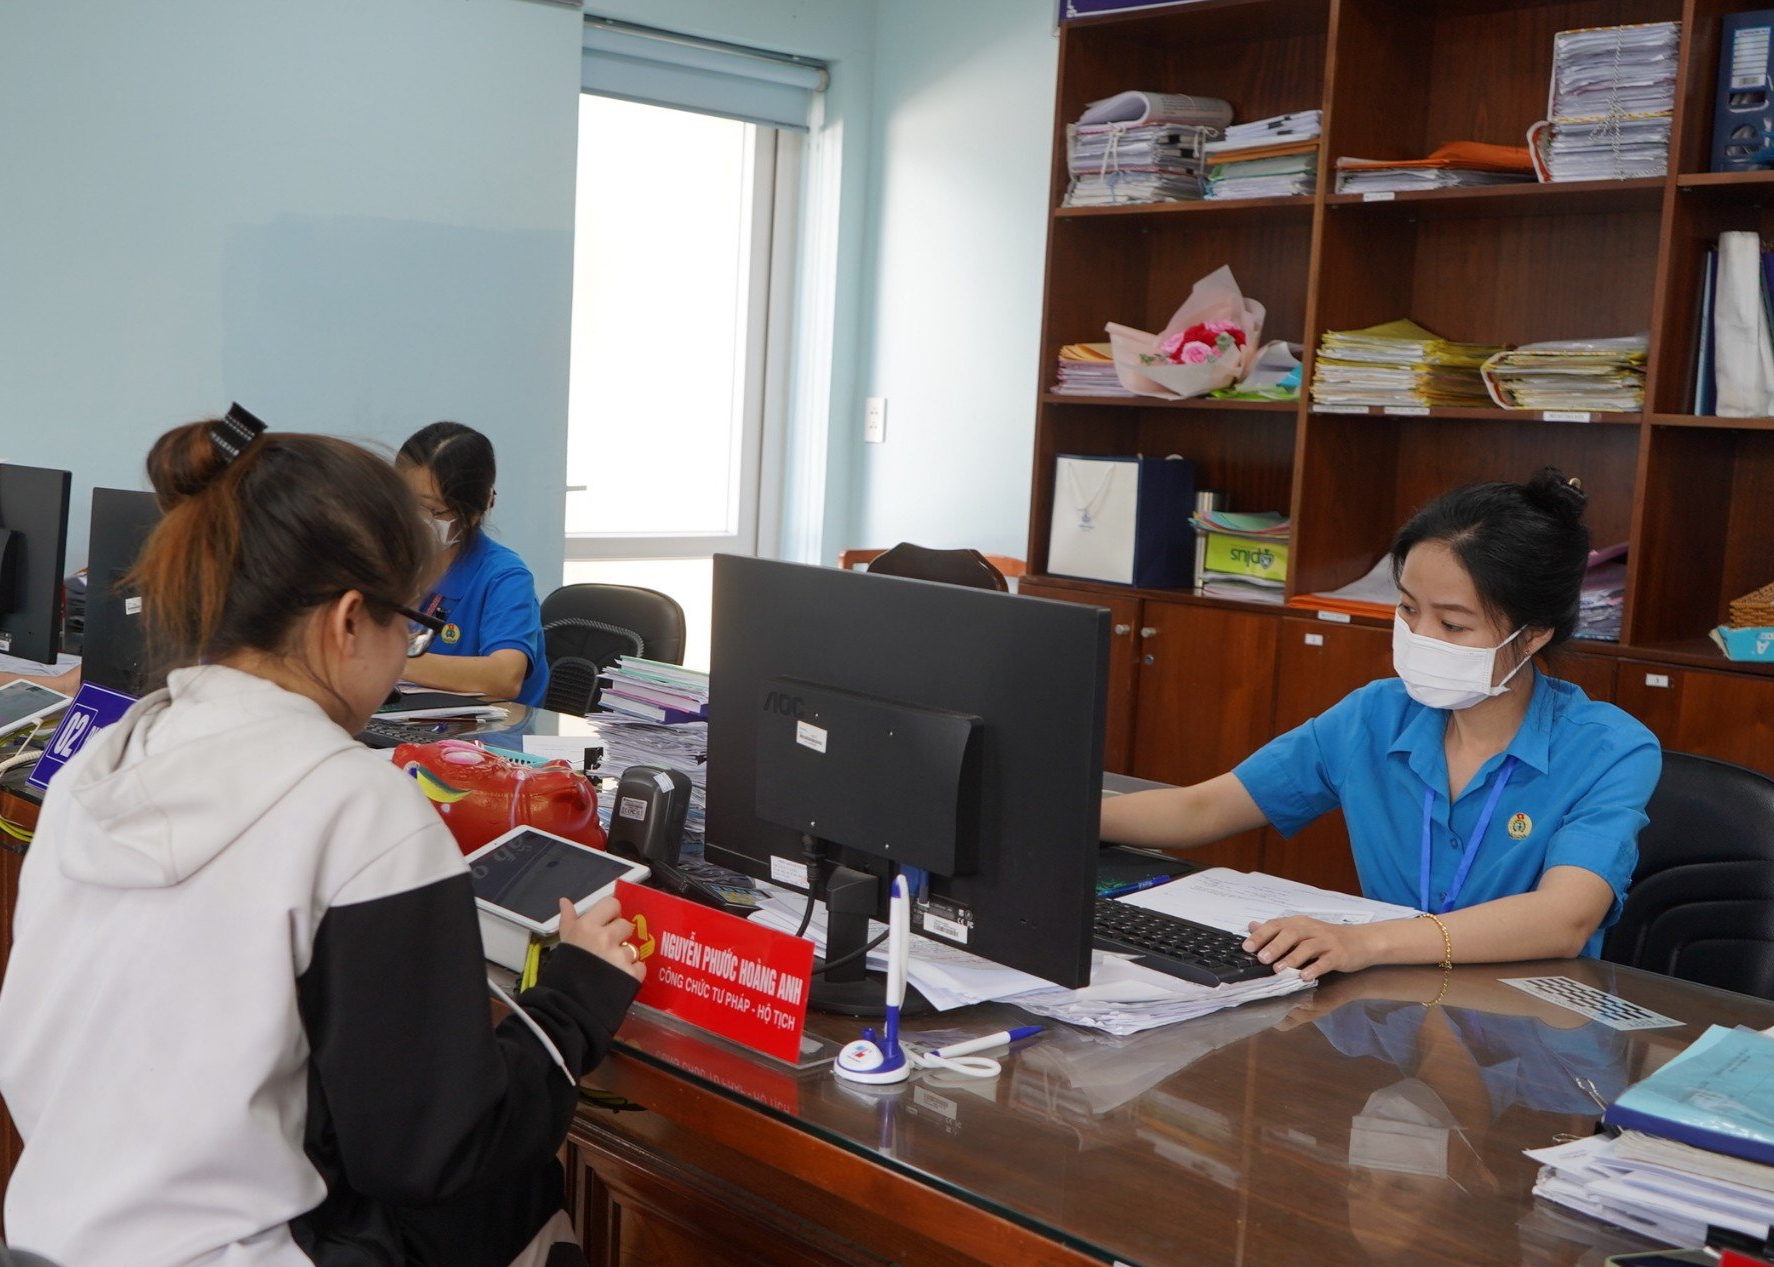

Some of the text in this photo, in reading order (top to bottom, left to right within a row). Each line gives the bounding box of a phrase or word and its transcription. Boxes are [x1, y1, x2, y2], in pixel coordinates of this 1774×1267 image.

[53, 711, 90, 758] 02
[659, 966, 684, 989] CÔNG
[685, 976, 711, 999] CHỨC
[712, 986, 726, 1004] TƯ
[725, 992, 751, 1013] PHÁP
[757, 1002, 772, 1025] HỘ
[773, 1009, 796, 1032] TỊCH
[660, 931, 803, 1006] NGUYỄN PHƯỚC HOÀNG ANH
